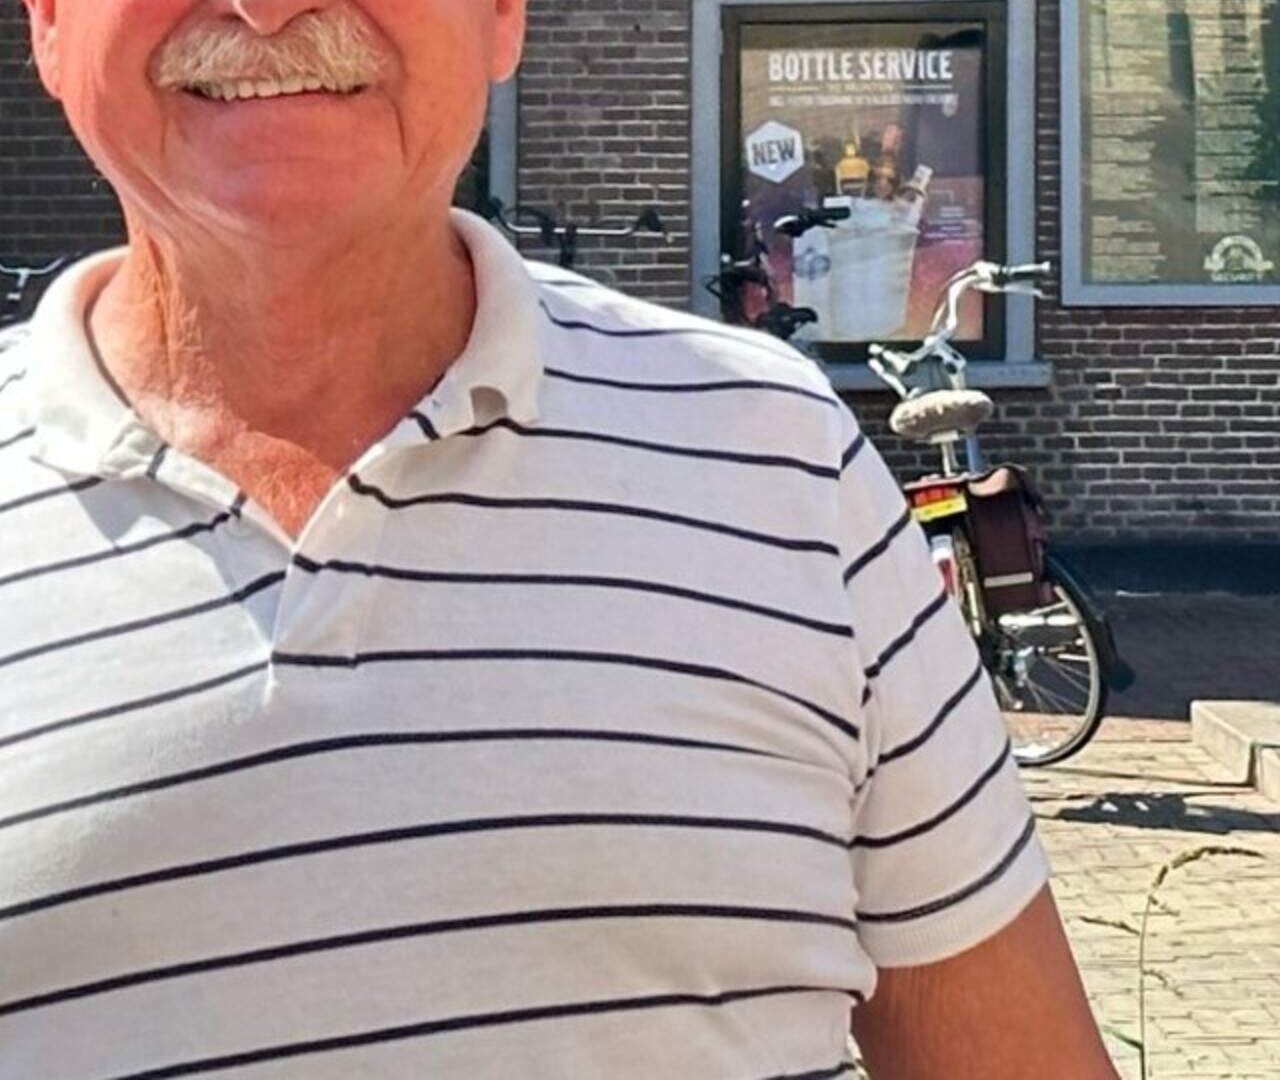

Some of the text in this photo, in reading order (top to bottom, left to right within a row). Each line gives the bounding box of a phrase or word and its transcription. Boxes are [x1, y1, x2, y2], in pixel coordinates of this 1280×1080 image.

[769, 49, 954, 81] BOTTLE SERVICE
[752, 137, 795, 166] NEW
